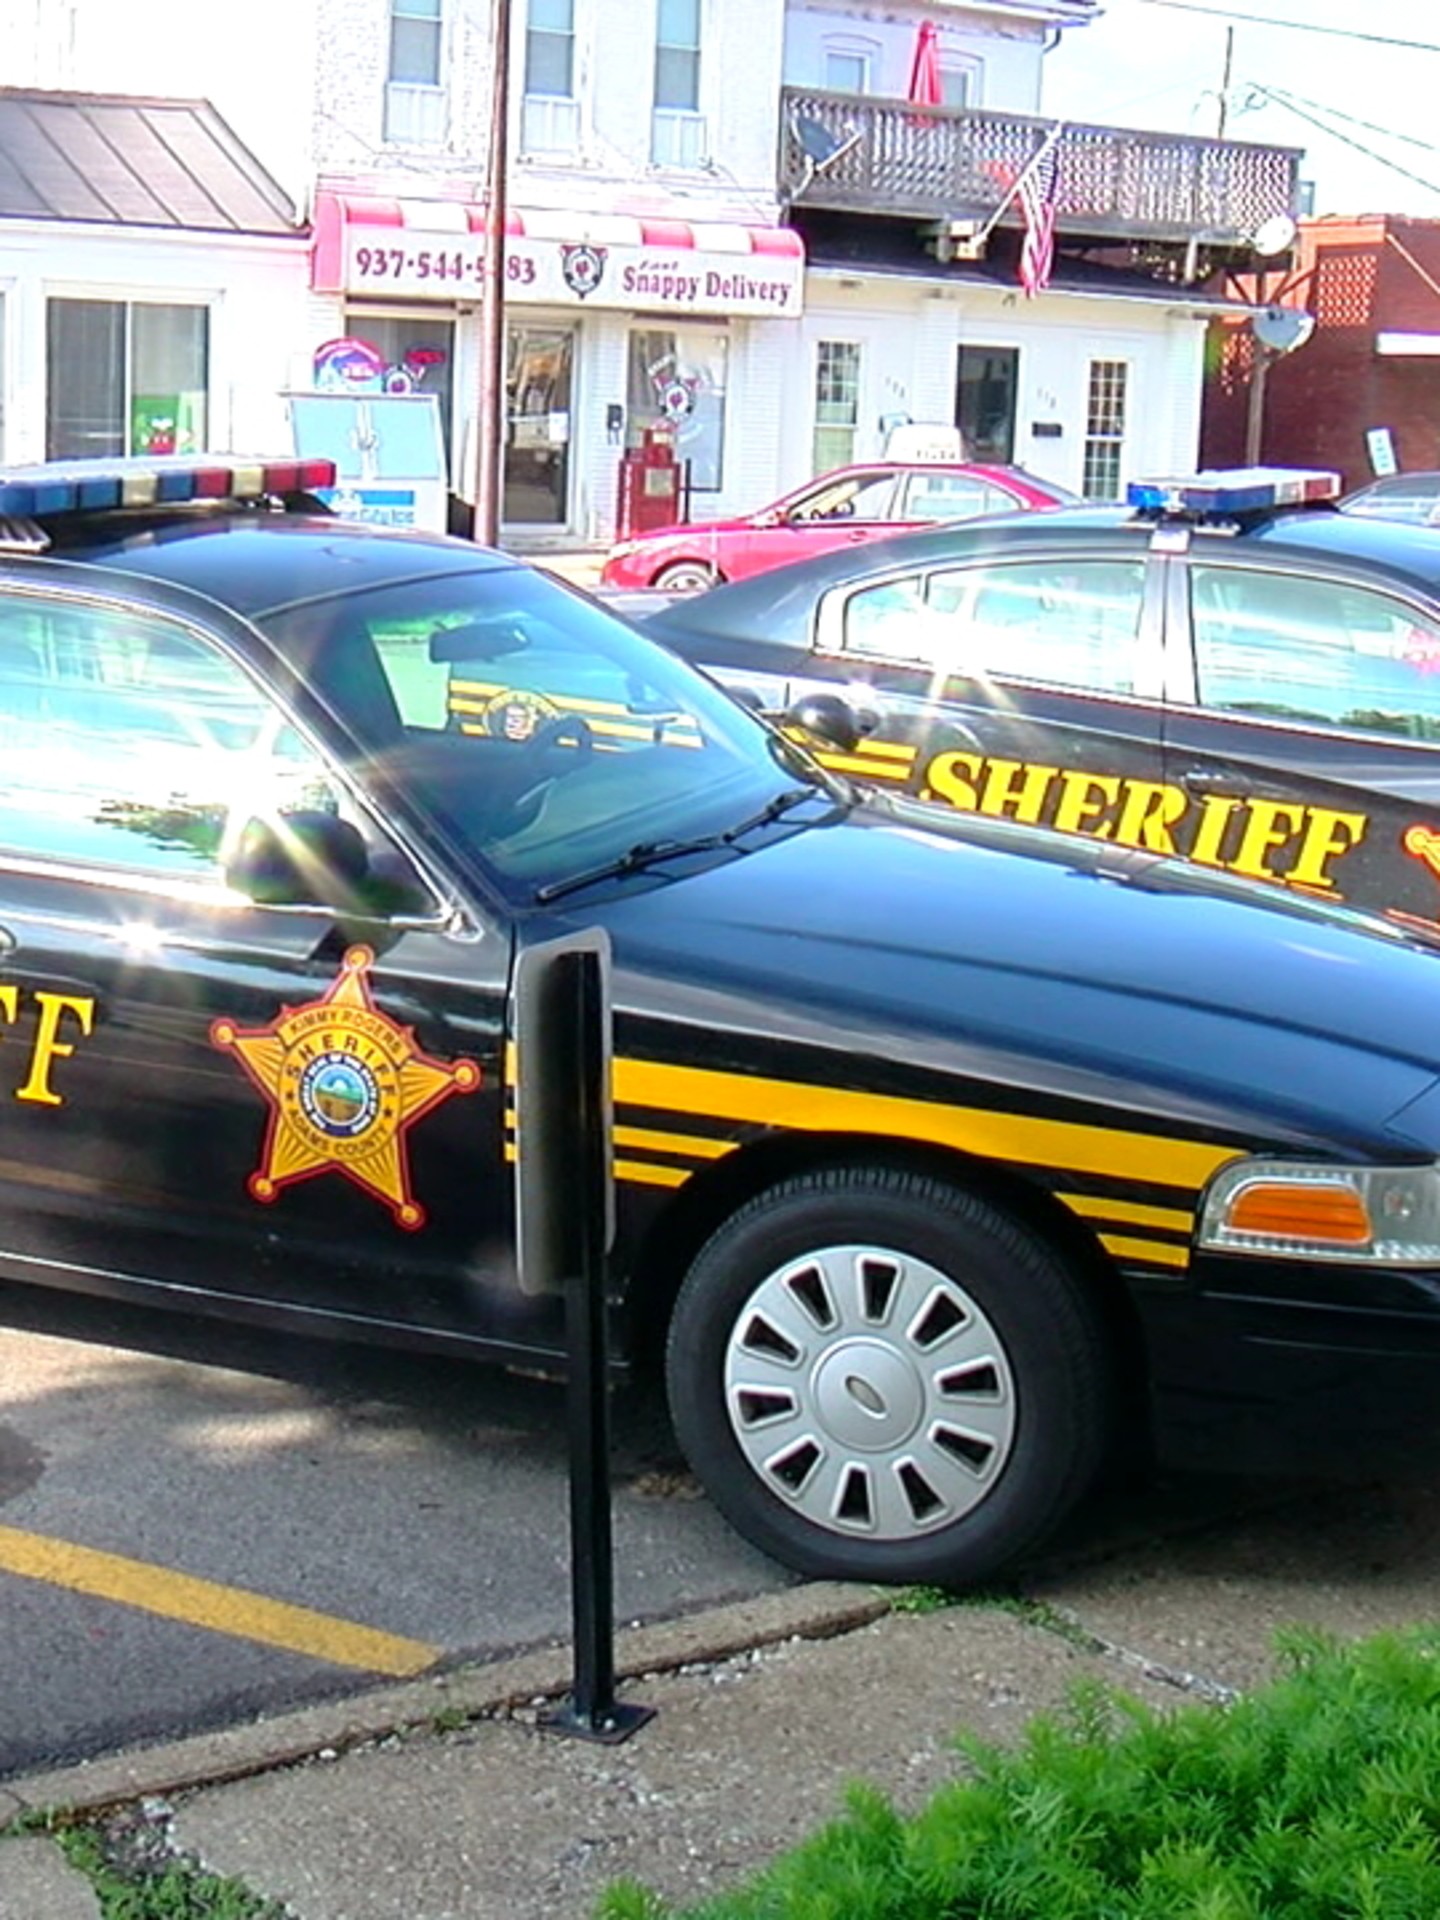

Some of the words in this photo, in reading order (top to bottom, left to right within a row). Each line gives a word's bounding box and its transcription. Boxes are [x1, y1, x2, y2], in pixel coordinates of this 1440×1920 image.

[622, 265, 701, 302] Snappy
[705, 271, 793, 307] Delivery
[921, 750, 1367, 889] SHERIFF
[342, 1010, 402, 1054] ROGERS
[285, 1033, 397, 1093] SHERIFF
